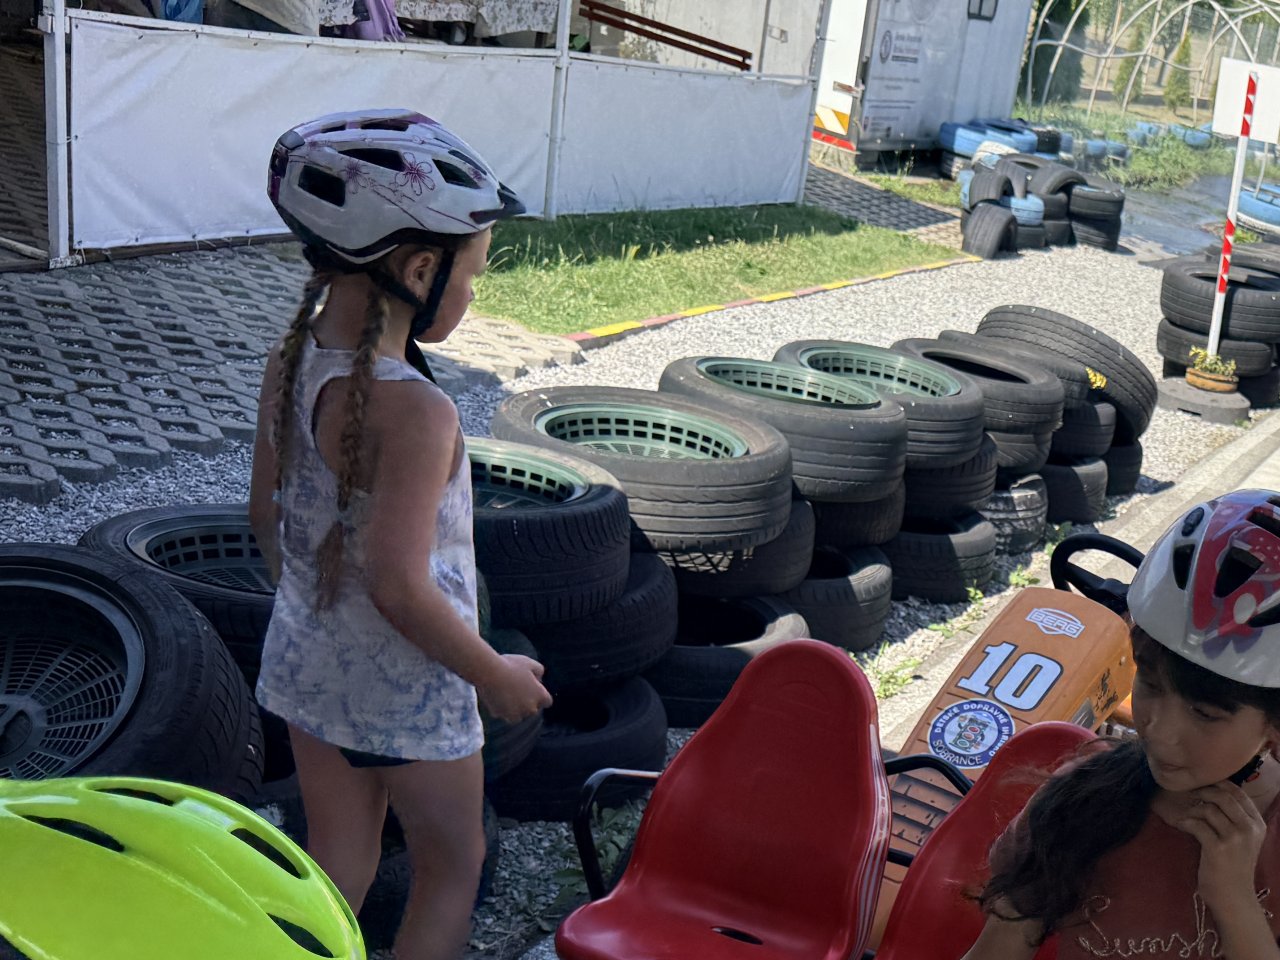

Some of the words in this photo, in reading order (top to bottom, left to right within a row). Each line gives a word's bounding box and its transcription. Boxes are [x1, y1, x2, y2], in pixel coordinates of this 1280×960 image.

[1030, 612, 1082, 637] BERG
[955, 641, 1064, 712] 10
[933, 739, 983, 766] SOBRANCE
[1078, 888, 1274, 958] Sunsh
